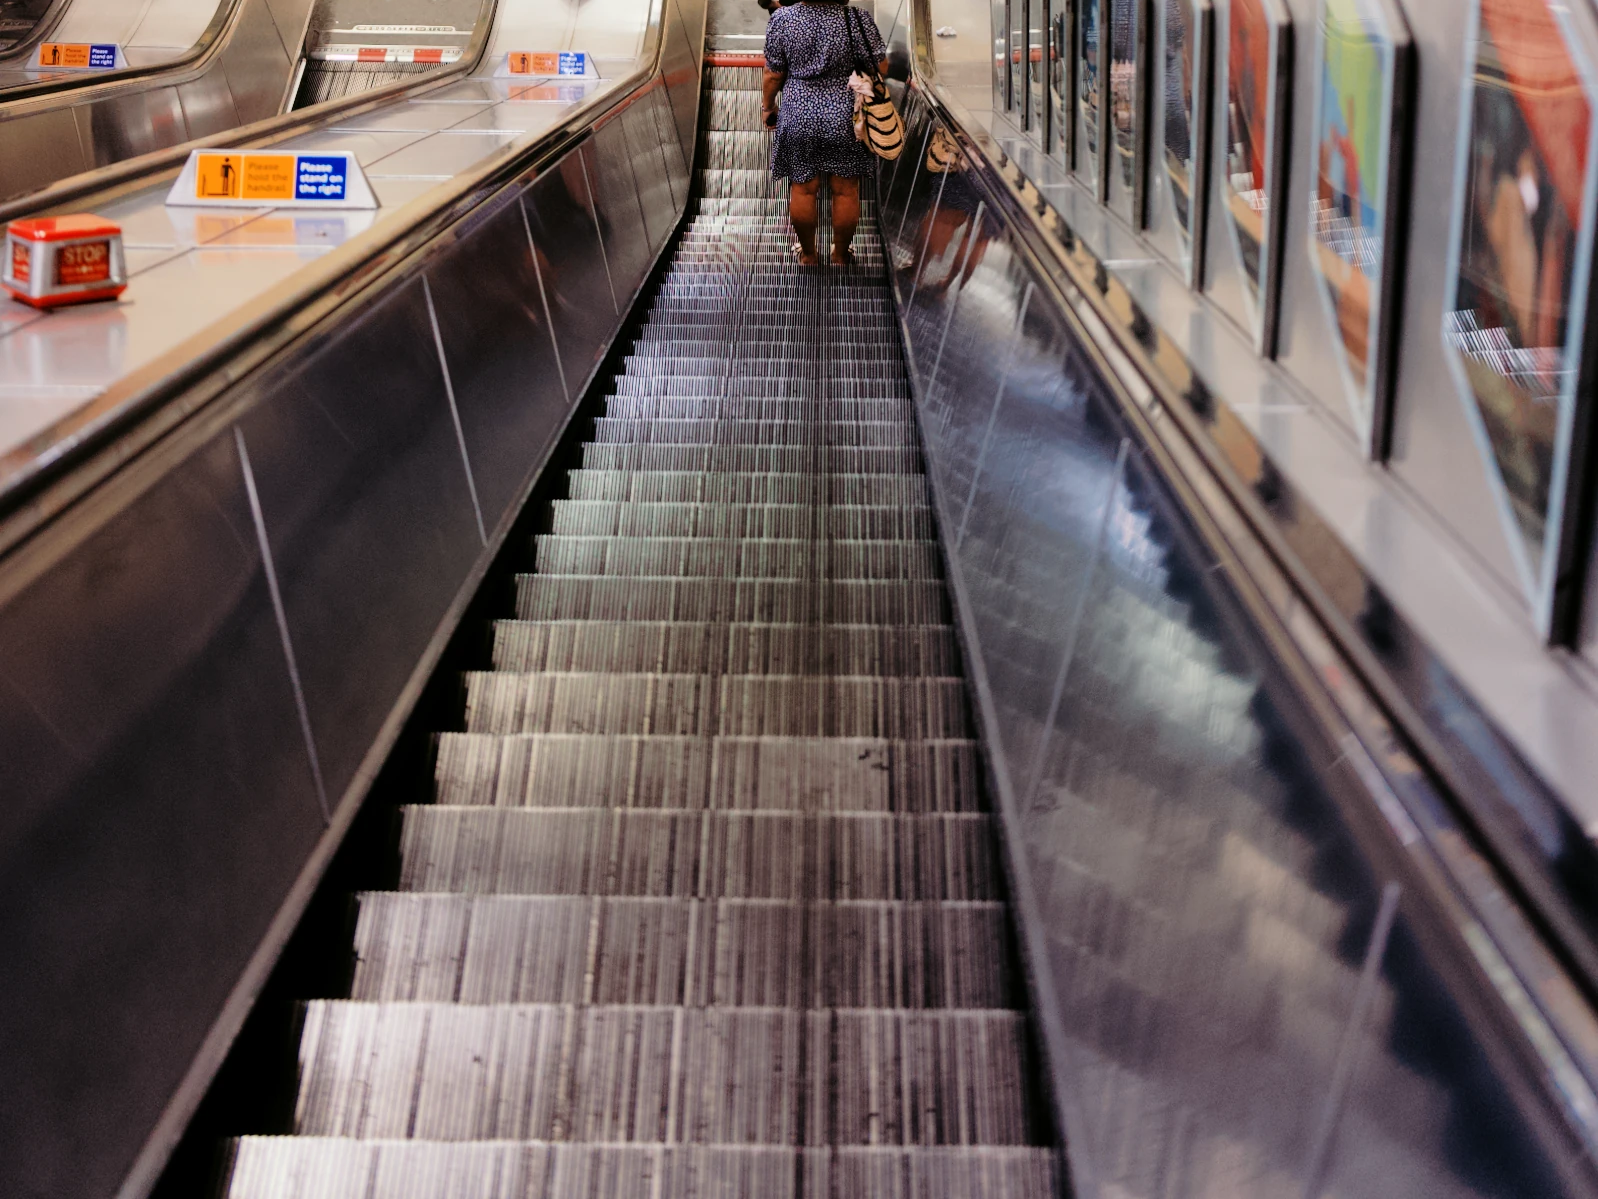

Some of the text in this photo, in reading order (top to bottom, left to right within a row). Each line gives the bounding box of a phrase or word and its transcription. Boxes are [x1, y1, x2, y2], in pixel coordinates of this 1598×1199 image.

[300, 161, 333, 173] Please
[299, 173, 344, 183] stand on
[298, 184, 342, 196] the right
[64, 243, 106, 264] STOP
